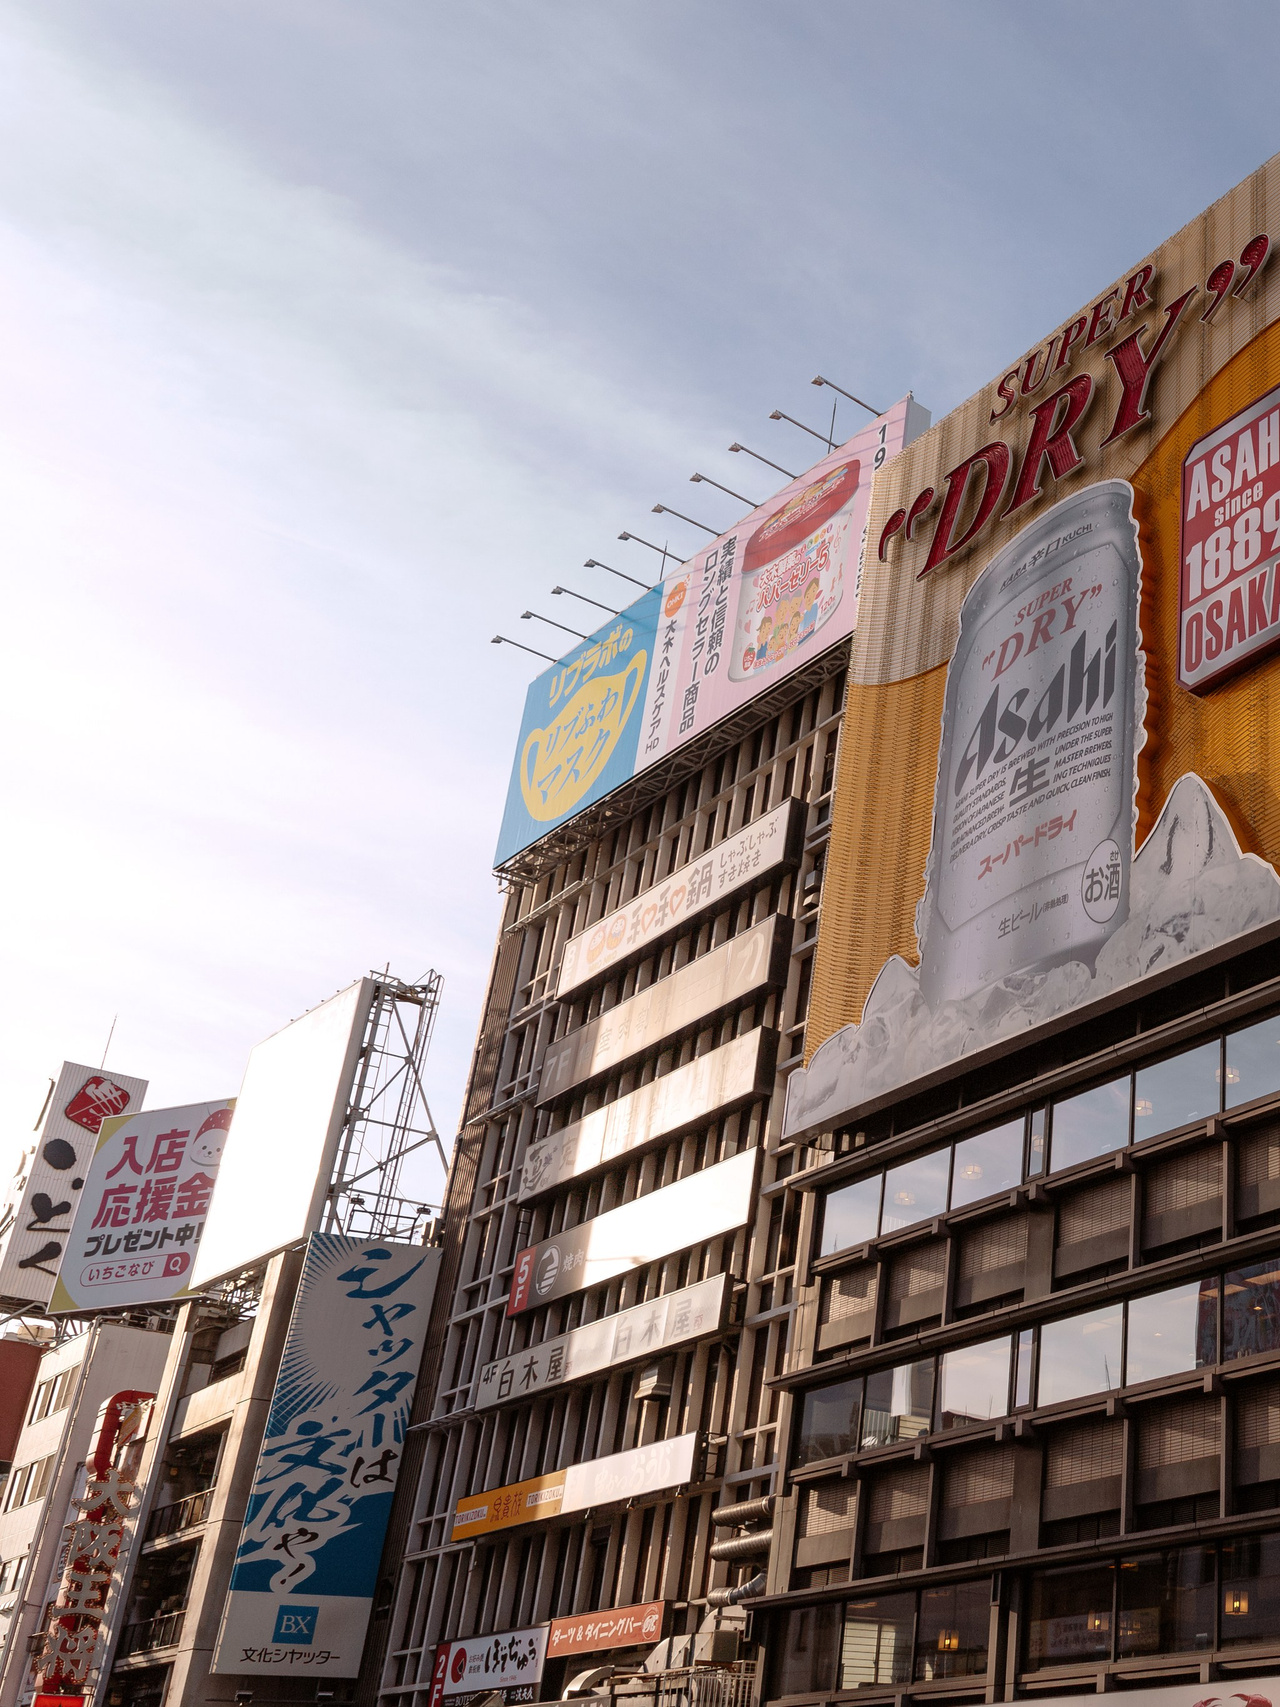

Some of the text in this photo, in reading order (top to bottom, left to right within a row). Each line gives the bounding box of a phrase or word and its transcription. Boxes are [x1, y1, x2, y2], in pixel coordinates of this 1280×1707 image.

[990, 264, 1156, 425] SUPER
[1214, 481, 1263, 527] since
[704, 535, 738, 676] 実績と信頼の
[1014, 577, 1073, 627] SUPER
[549, 623, 633, 708] リブラボの
[677, 549, 719, 736] ロングセラー商品
[955, 619, 1117, 797] Asahi
[1008, 746, 1036, 770] BREWED
[1037, 735, 1056, 751] WITH
[1057, 720, 1090, 741] PRECISION
[1091, 716, 1099, 726] TO
[1054, 737, 1079, 755] UNDER
[1080, 732, 1094, 744] THE
[1054, 750, 1084, 769] MASTER
[1069, 754, 1111, 776] TECHNIQUES
[1006, 803, 1028, 822] TASTE
[1027, 793, 1045, 810] AND
[1070, 773, 1092, 788] CLEAN
[1009, 757, 1050, 808] 生
[718, 849, 762, 889] すき焼き
[977, 809, 1077, 880] スーパードライ
[1084, 862, 1120, 903] お酒
[544, 1047, 572, 1089] 7F
[105, 1128, 191, 1180] 入店
[90, 1172, 216, 1230] 応援金
[88, 1262, 155, 1282] いちごなび
[514, 1254, 531, 1308] 5F
[561, 1249, 584, 1272] 焼肉
[614, 1298, 692, 1359] 白木屋
[483, 1364, 498, 1385] 4F
[497, 1345, 564, 1400] 白木屋
[37, 1468, 134, 1682] 大阪王将
[280, 1615, 312, 1634] BX
[431, 1654, 446, 1707] 2F
